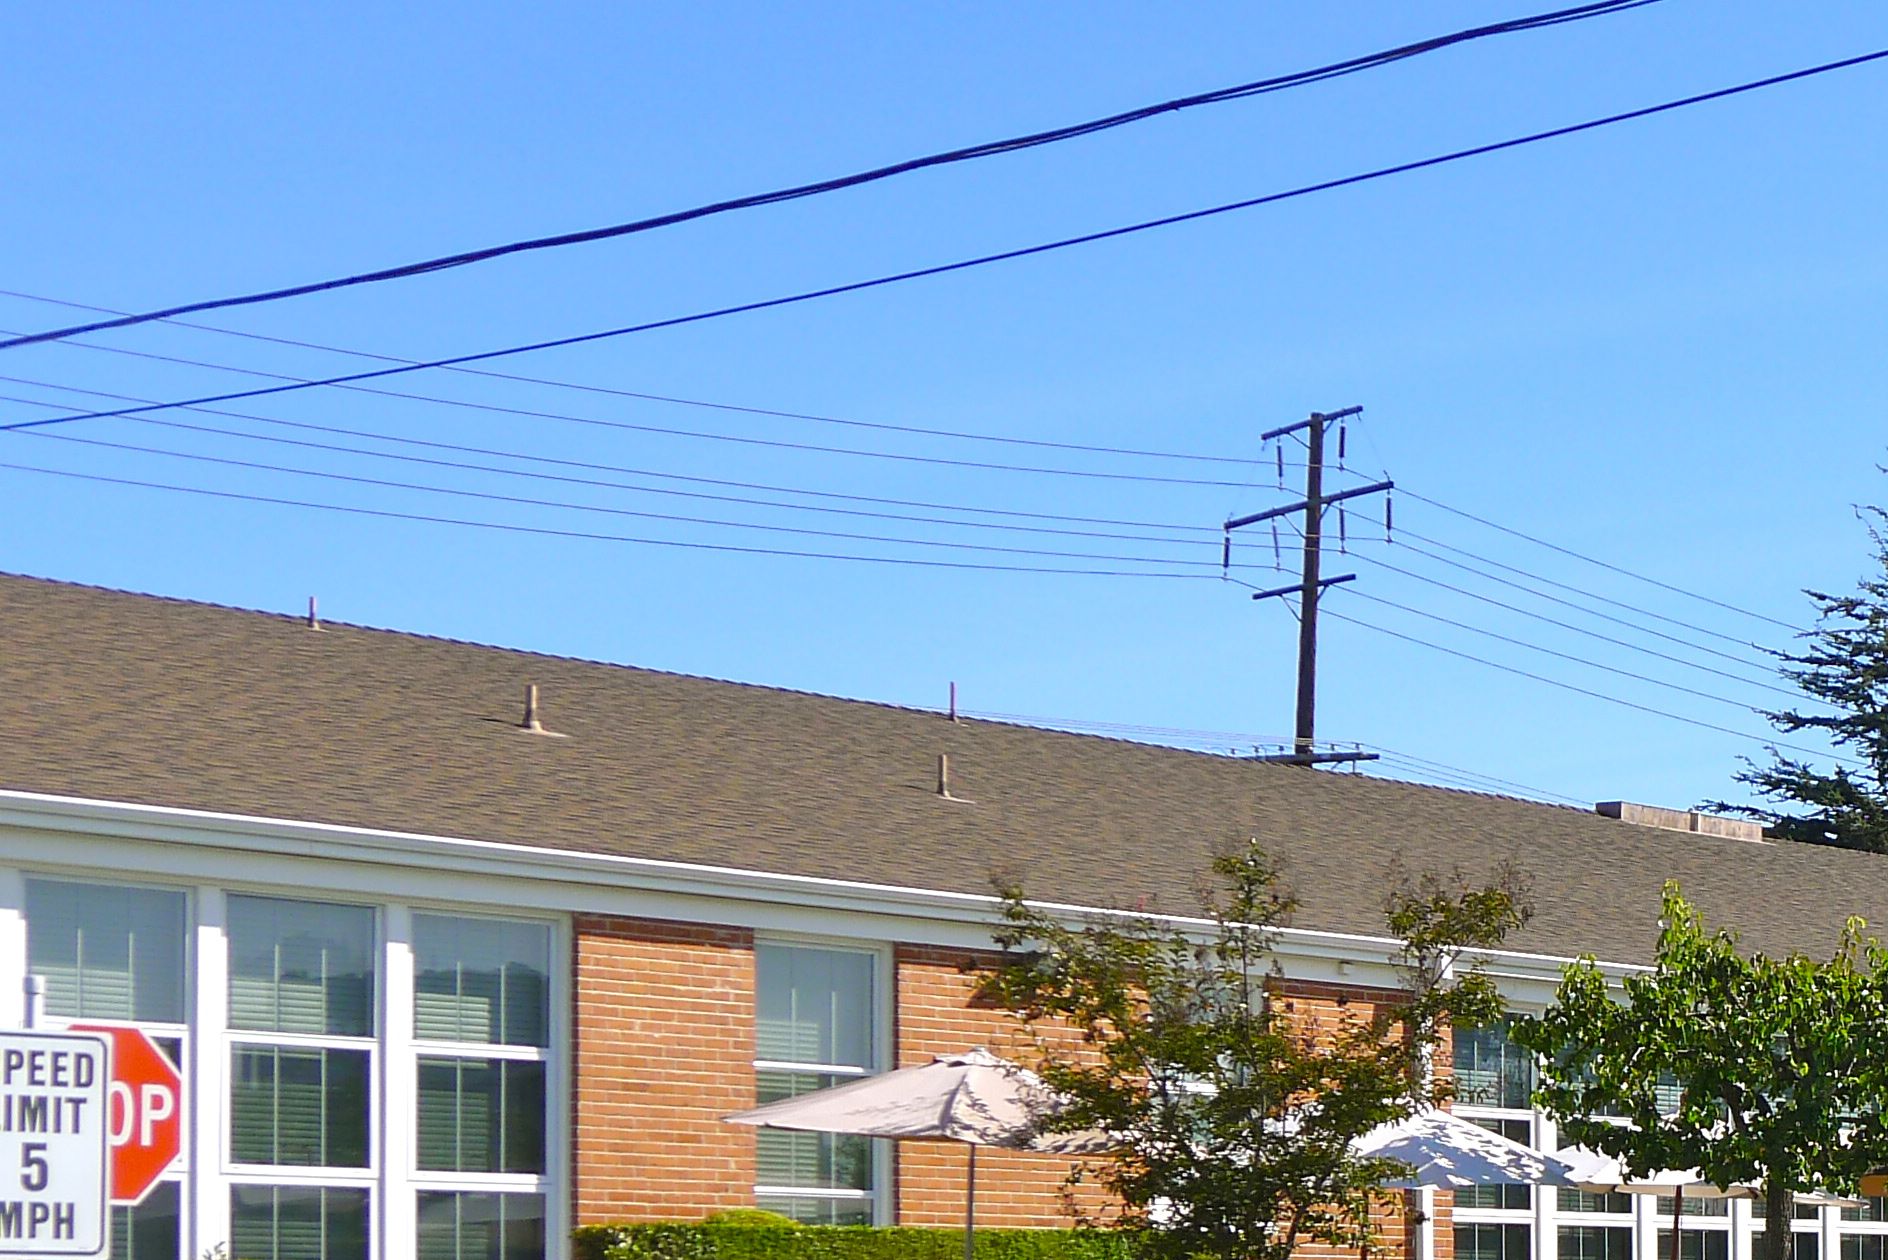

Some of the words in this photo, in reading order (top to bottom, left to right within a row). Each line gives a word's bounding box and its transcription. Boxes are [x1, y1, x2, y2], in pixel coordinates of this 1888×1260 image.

[3, 1050, 94, 1088] PEED
[0, 1094, 87, 1134] IMIT
[108, 1080, 174, 1147] OP
[20, 1142, 49, 1192] 5
[0, 1201, 75, 1239] MPH
